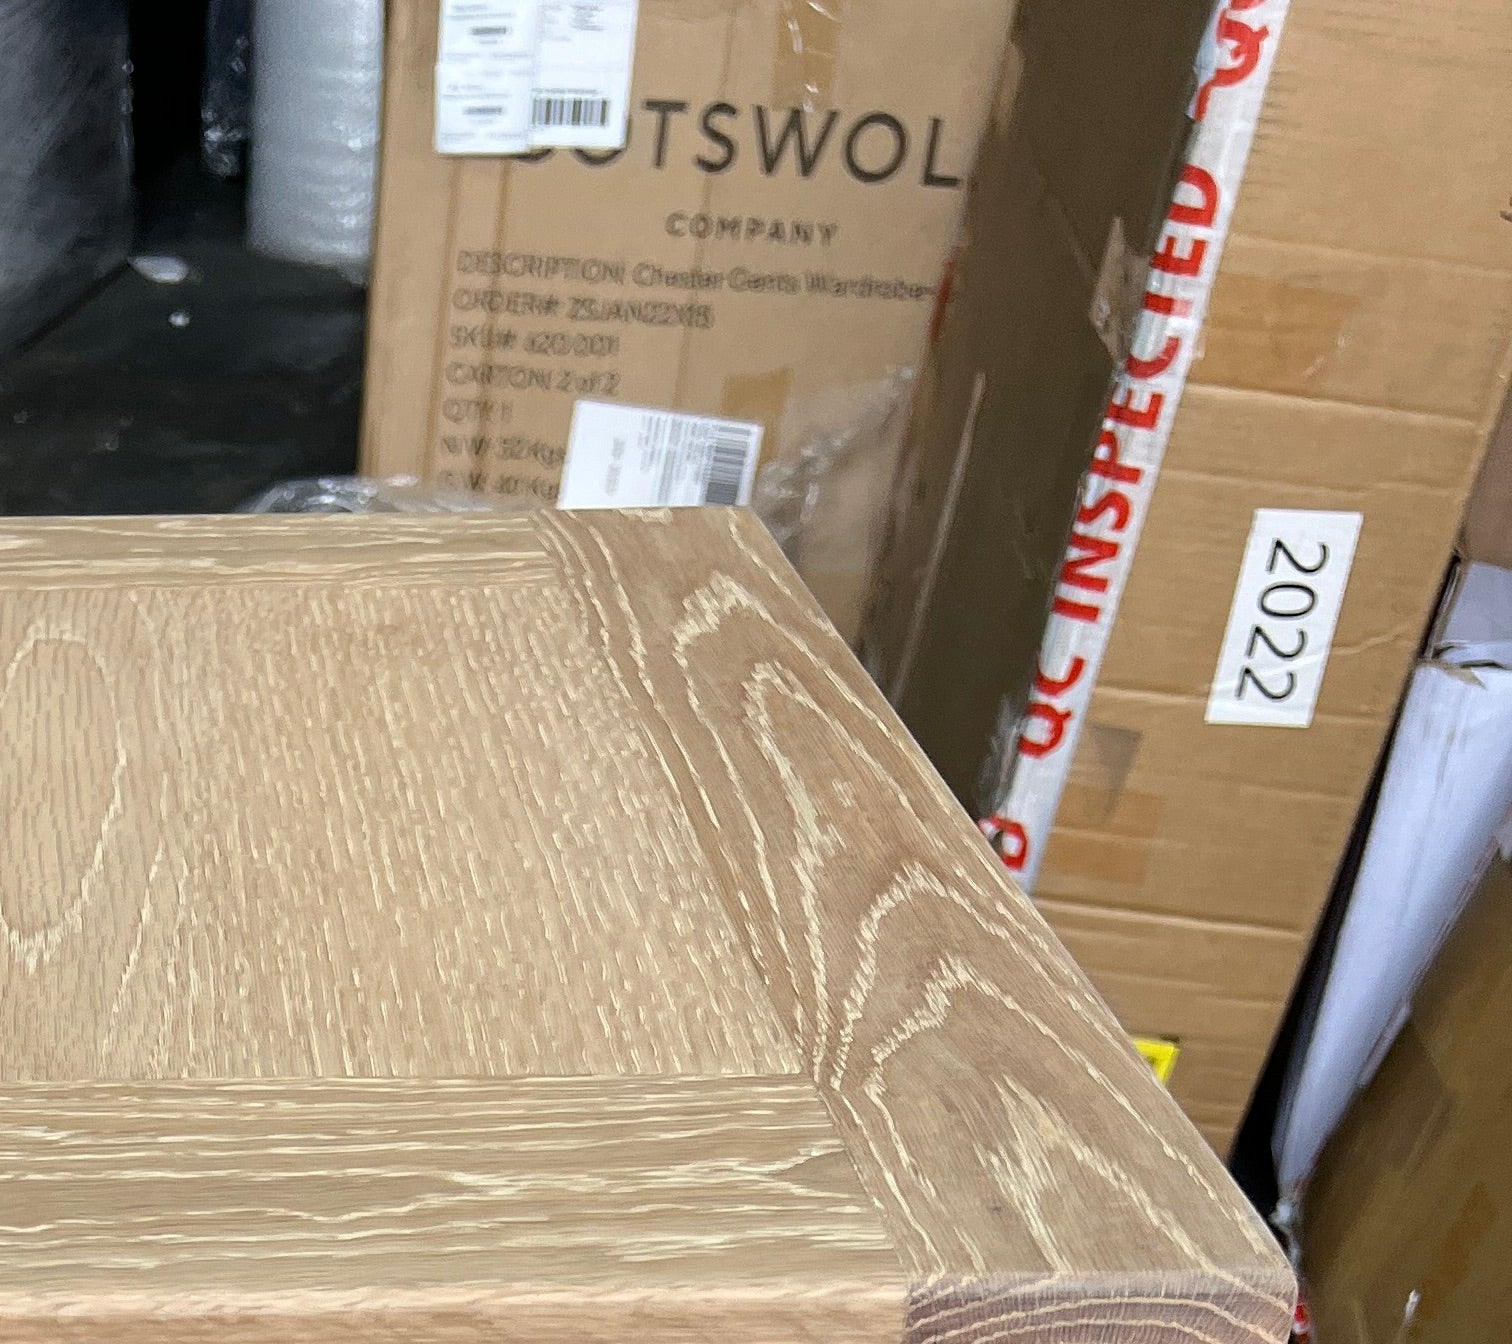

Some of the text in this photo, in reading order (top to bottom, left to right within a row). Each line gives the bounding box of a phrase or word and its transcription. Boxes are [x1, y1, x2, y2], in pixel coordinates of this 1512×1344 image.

[514, 98, 961, 189] TSWOL
[664, 211, 839, 246] COMPANY
[1018, 656, 1086, 759] QC
[1052, 174, 1221, 624] INSPECTED
[1234, 536, 1331, 703] 2022
